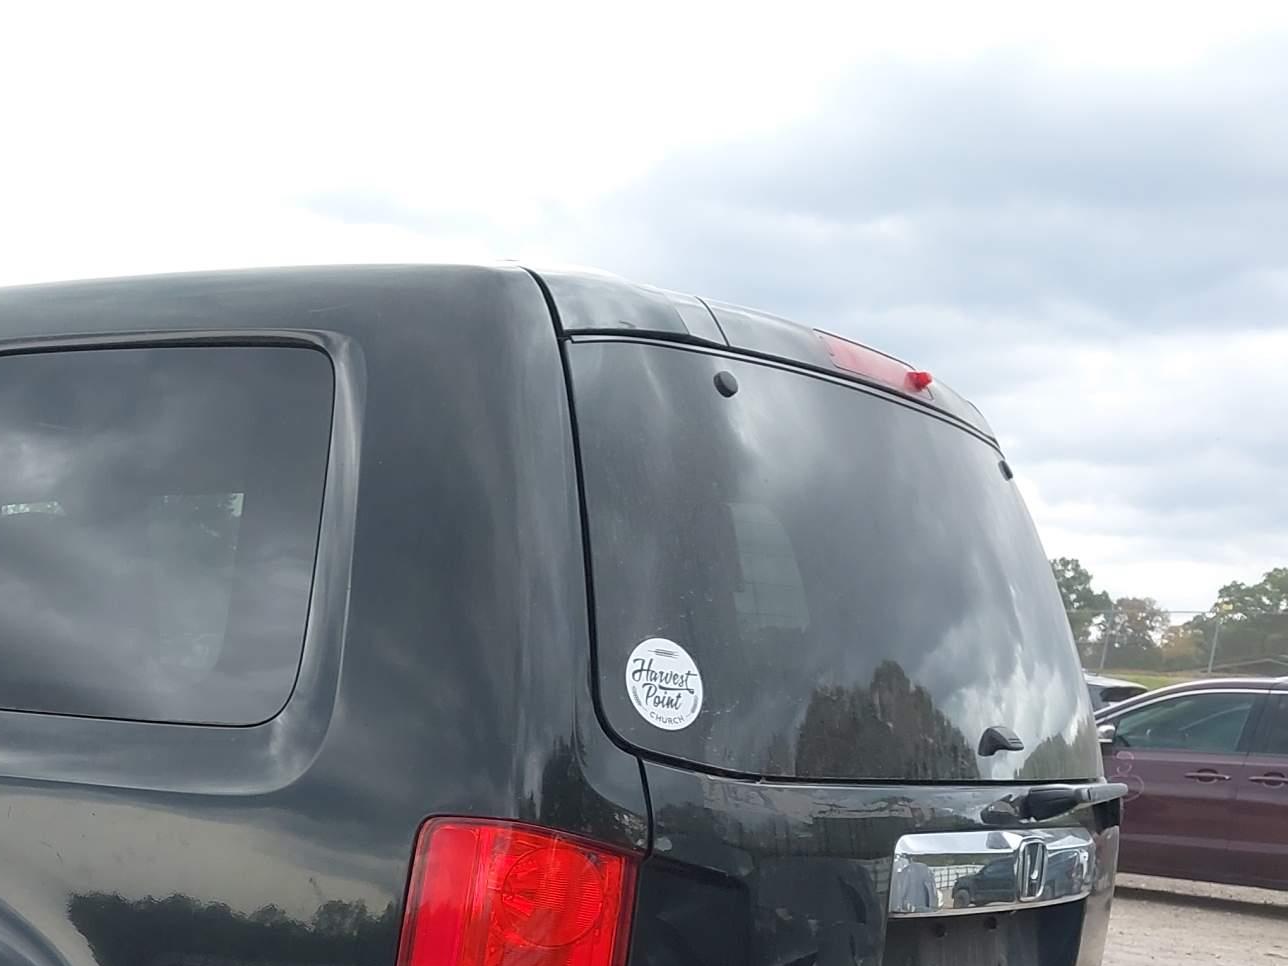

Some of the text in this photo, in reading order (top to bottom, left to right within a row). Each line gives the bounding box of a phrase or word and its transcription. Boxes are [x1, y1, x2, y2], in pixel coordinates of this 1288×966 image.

[631, 658, 698, 694] Harvest
[641, 682, 683, 710] Point
[649, 711, 685, 725] CHURCH
